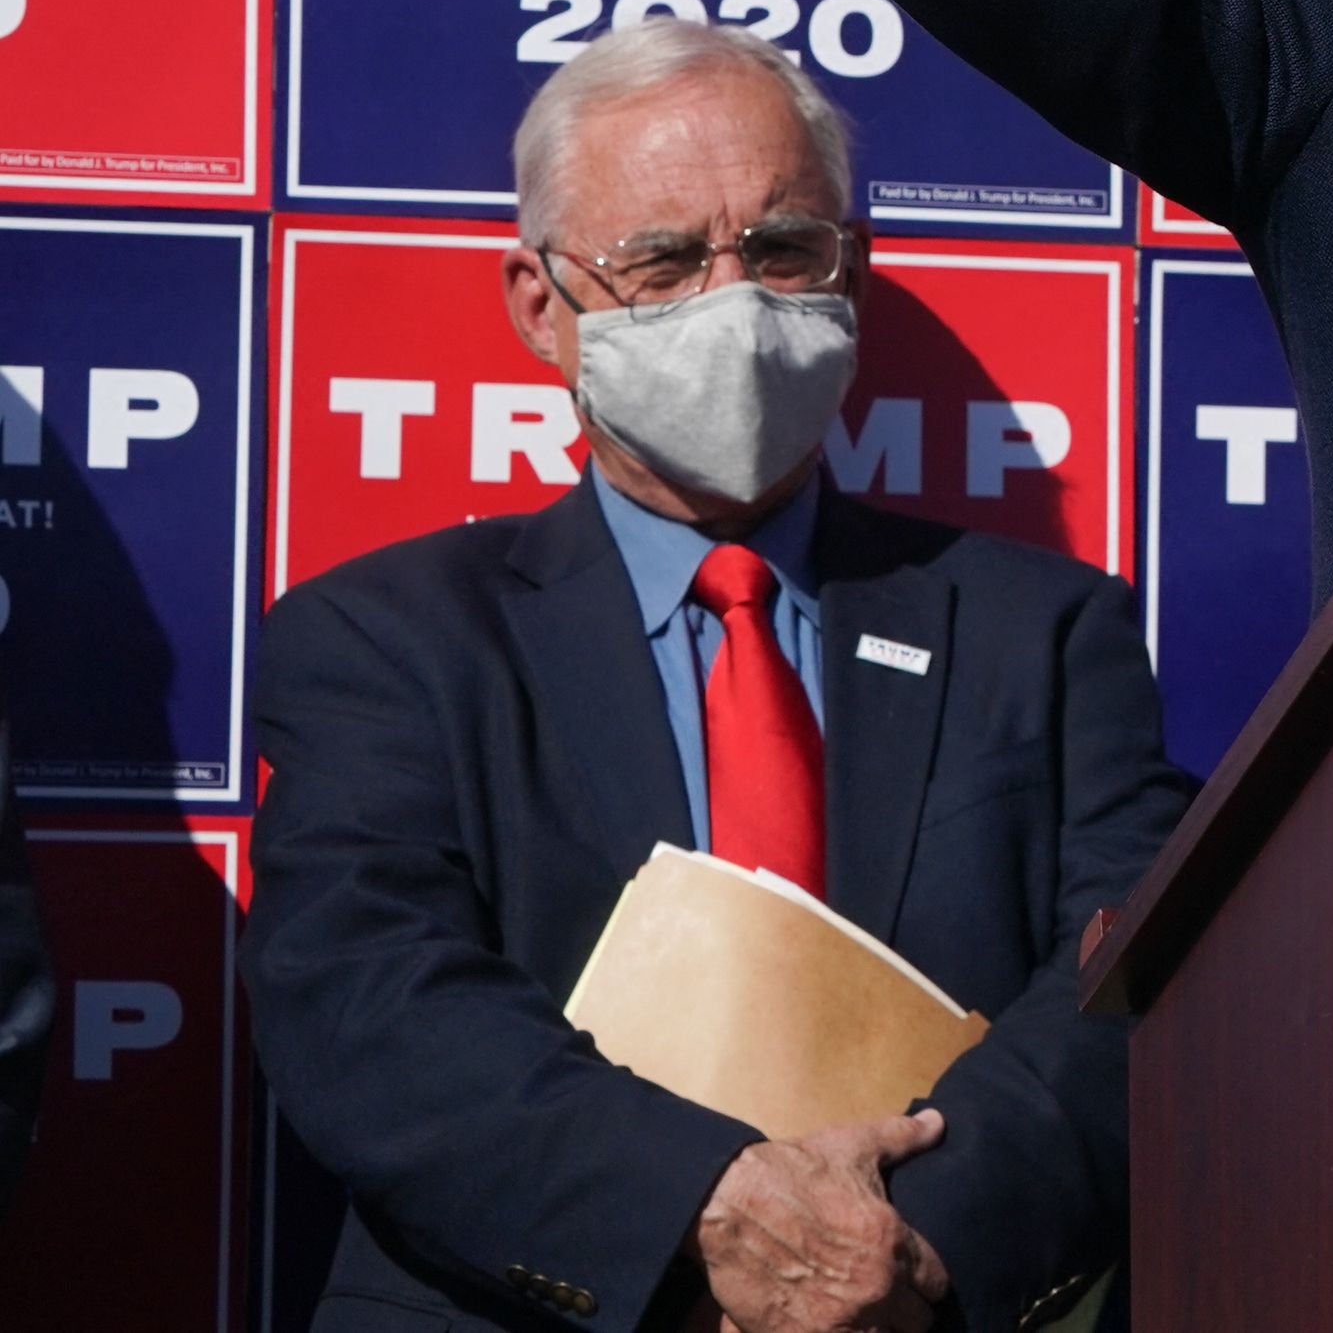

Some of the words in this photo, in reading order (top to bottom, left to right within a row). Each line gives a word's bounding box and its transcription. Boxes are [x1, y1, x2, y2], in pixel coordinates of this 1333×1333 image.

[1, 152, 23, 166] Paid
[56, 155, 94, 169] Donald
[105, 157, 138, 172] Trump
[157, 160, 208, 174] President,
[879, 185, 900, 199] Paid
[932, 188, 968, 202] Donald
[979, 190, 1011, 204] Trump
[329, 376, 1072, 499] TRMP
